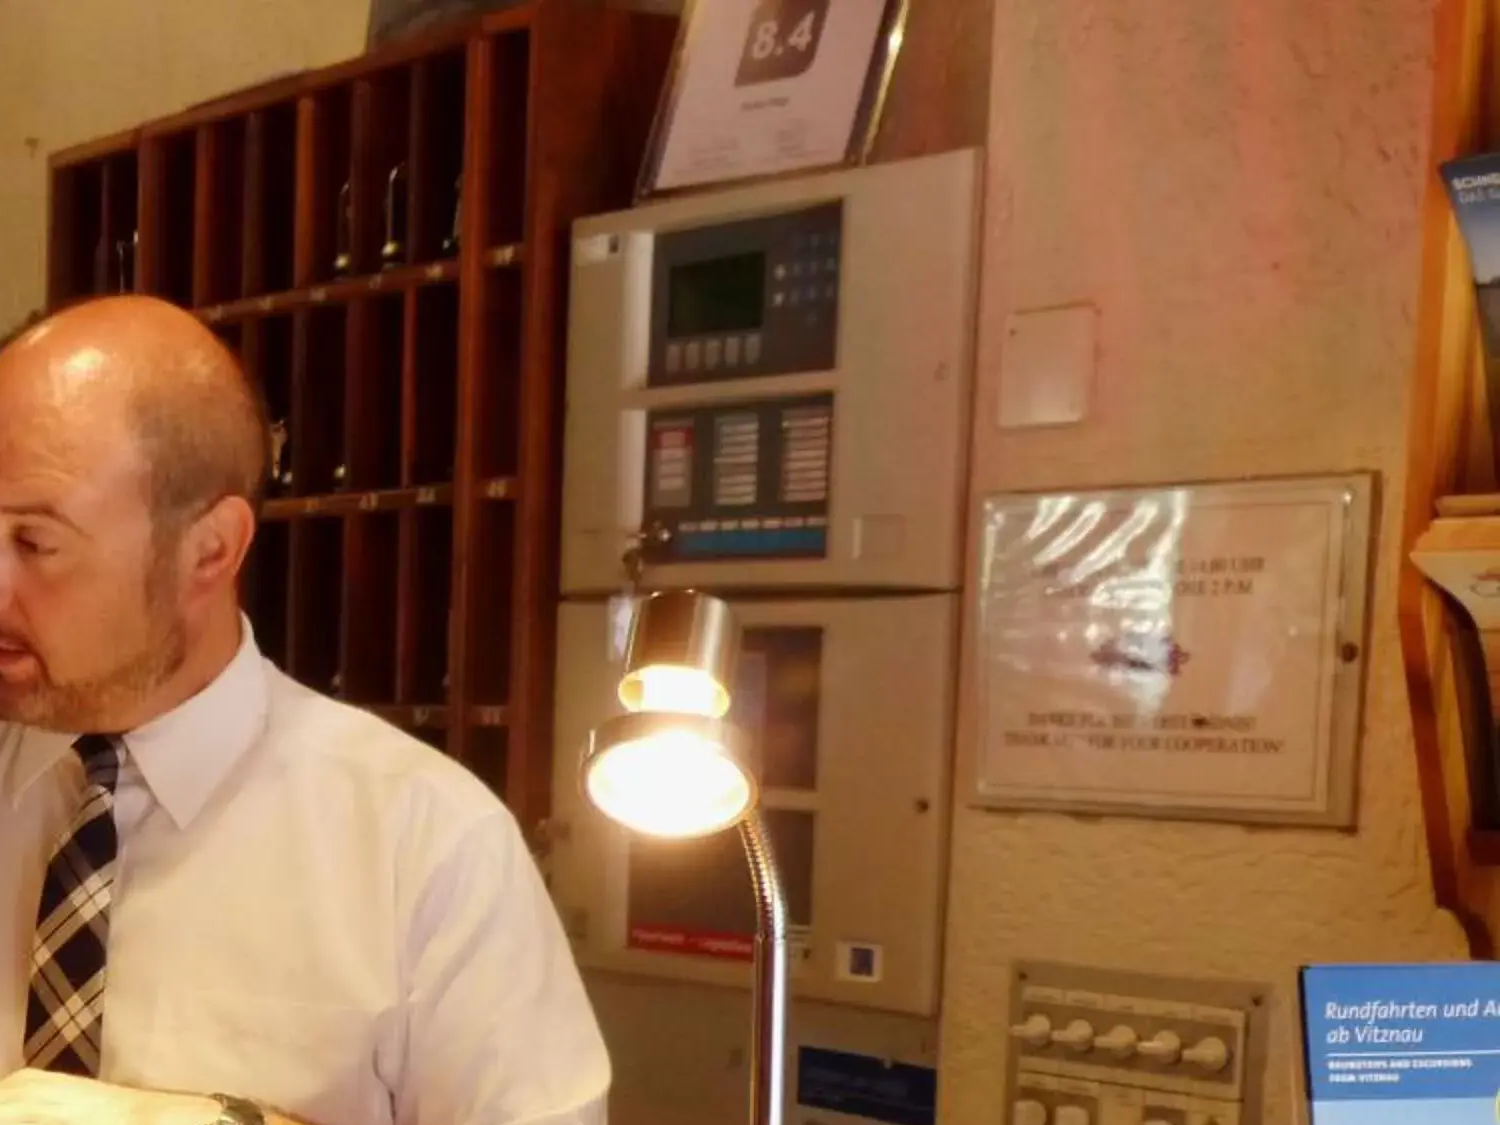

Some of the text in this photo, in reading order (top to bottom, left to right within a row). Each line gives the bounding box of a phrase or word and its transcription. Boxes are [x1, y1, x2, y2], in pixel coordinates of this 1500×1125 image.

[752, 10, 816, 60] 8.4
[1325, 1000, 1437, 1025] Rundfahrten
[1443, 1000, 1479, 1018] und
[1326, 1026, 1423, 1044] ab Vitznau
